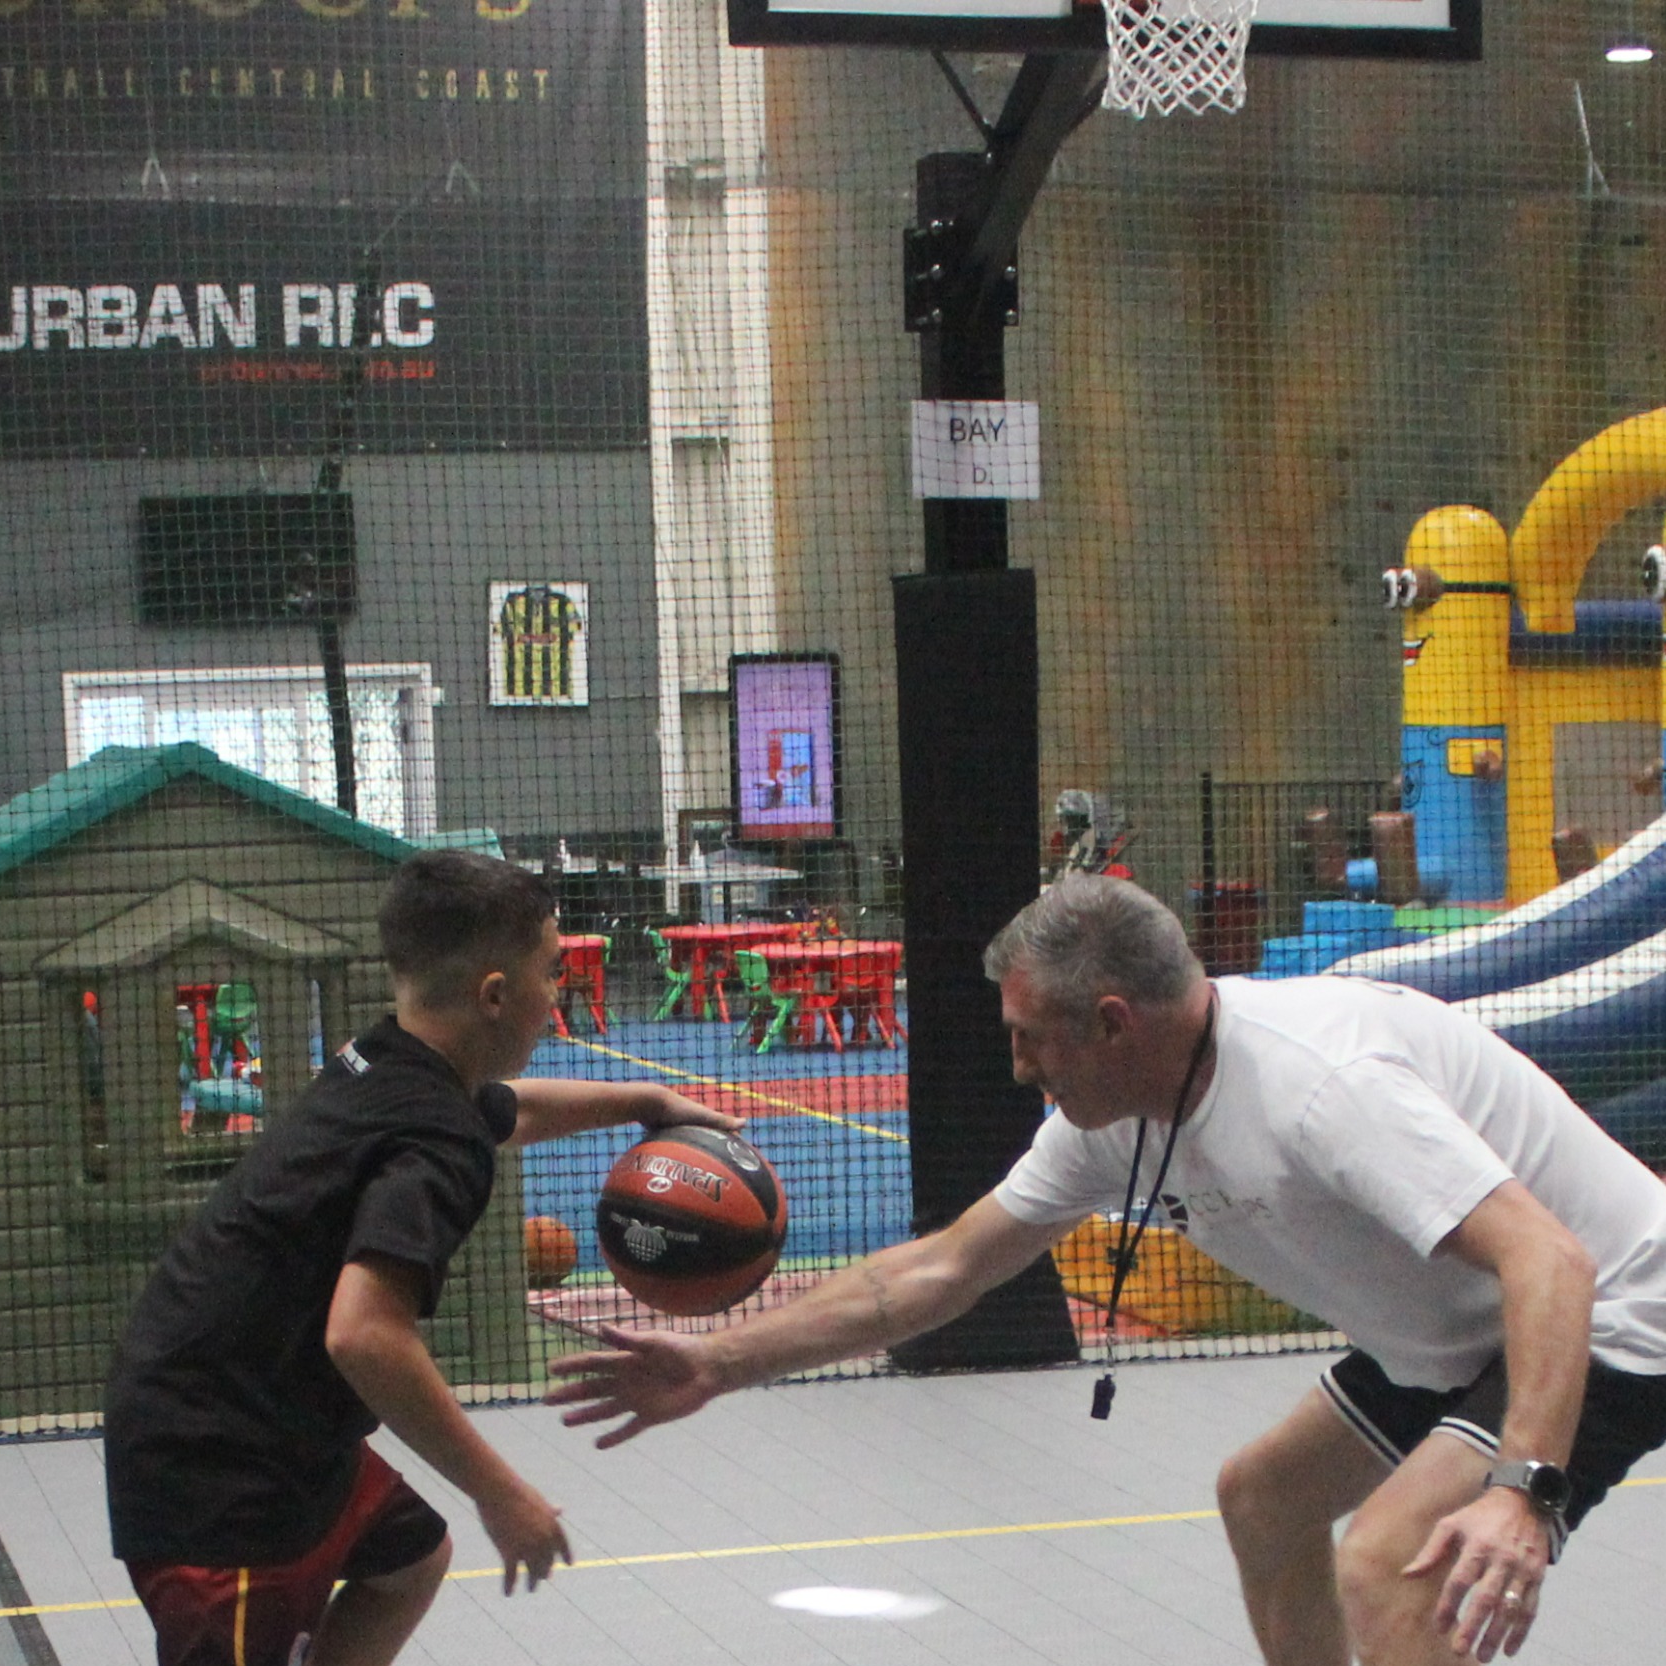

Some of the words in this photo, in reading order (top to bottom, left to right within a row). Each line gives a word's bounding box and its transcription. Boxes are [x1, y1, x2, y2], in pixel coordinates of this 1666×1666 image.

[179, 67, 376, 99] CENTRAL
[416, 68, 550, 99] COAST
[950, 418, 1004, 442] BAY
[972, 466, 987, 484] D
